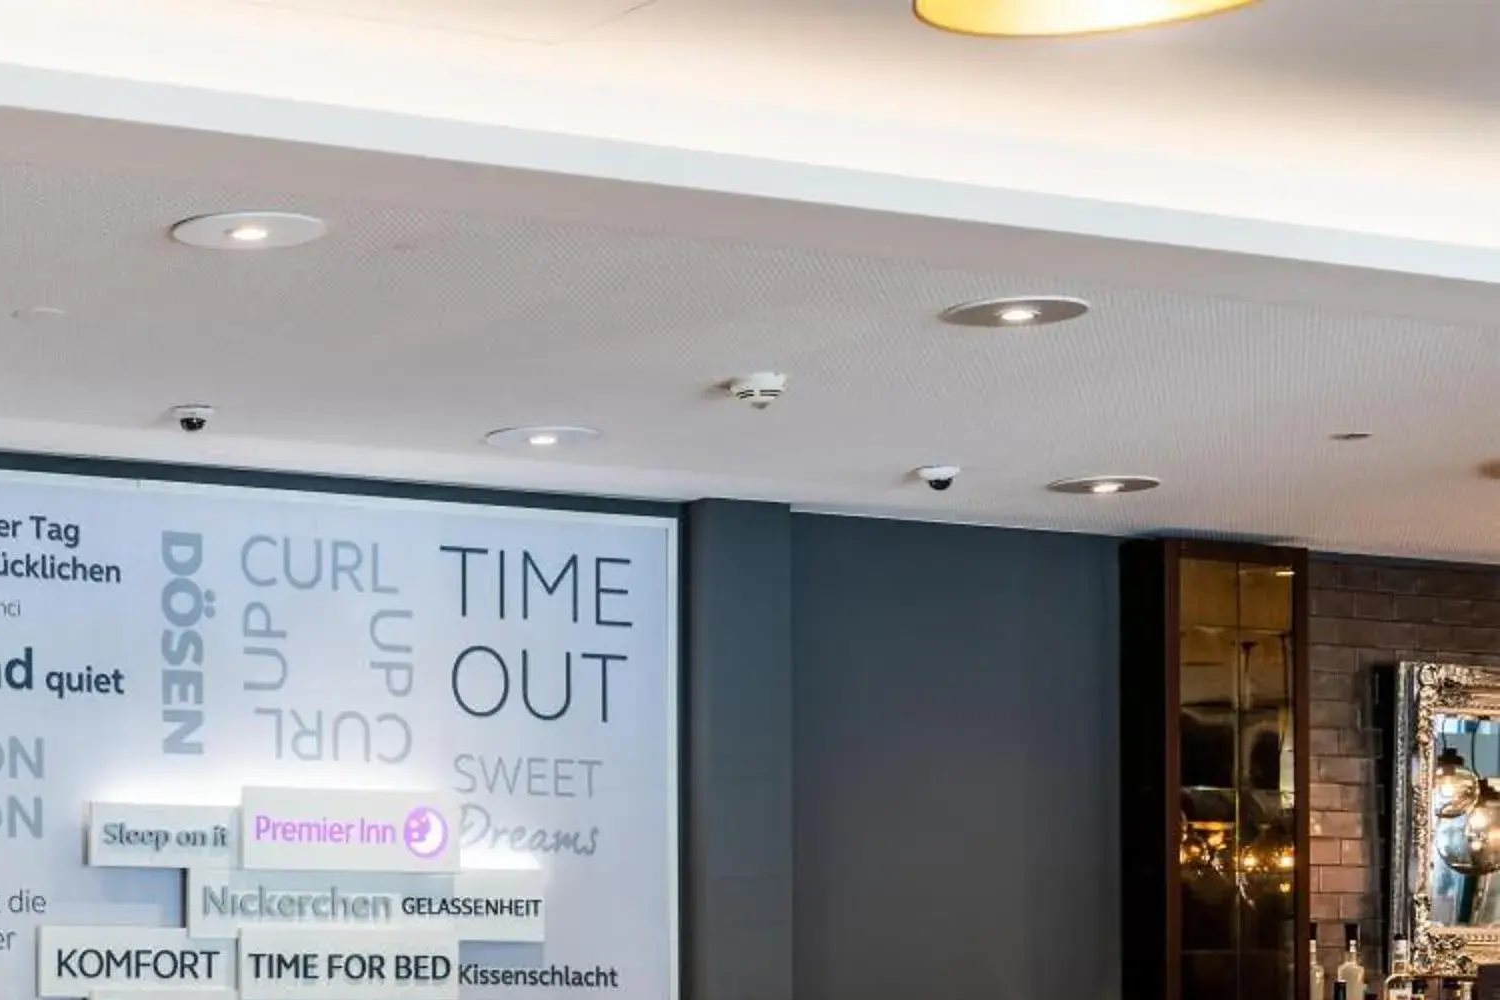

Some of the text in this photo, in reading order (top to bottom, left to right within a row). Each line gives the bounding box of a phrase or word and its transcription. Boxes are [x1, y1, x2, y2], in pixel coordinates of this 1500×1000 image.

[30, 515, 80, 548] Tag
[241, 534, 399, 595] CURL
[439, 545, 633, 628] TIME
[162, 530, 216, 755] DÖSEN
[243, 601, 288, 692] UP
[369, 610, 413, 698] UP
[46, 665, 124, 699] quiet
[452, 645, 627, 723] OUT
[254, 708, 413, 765] CURL
[454, 753, 604, 798] SWEET
[103, 823, 169, 851] Sleep
[176, 829, 207, 847] on
[255, 815, 395, 845] Premier Inn
[459, 802, 599, 857] Dreams
[7, 888, 48, 914] die
[202, 885, 392, 921] Nickerchen
[402, 897, 542, 917] GELASSENHEIT
[57, 949, 220, 980] KOMFORT
[248, 953, 451, 981] TIME FOR BED
[458, 964, 618, 987] Kissenschlacht
